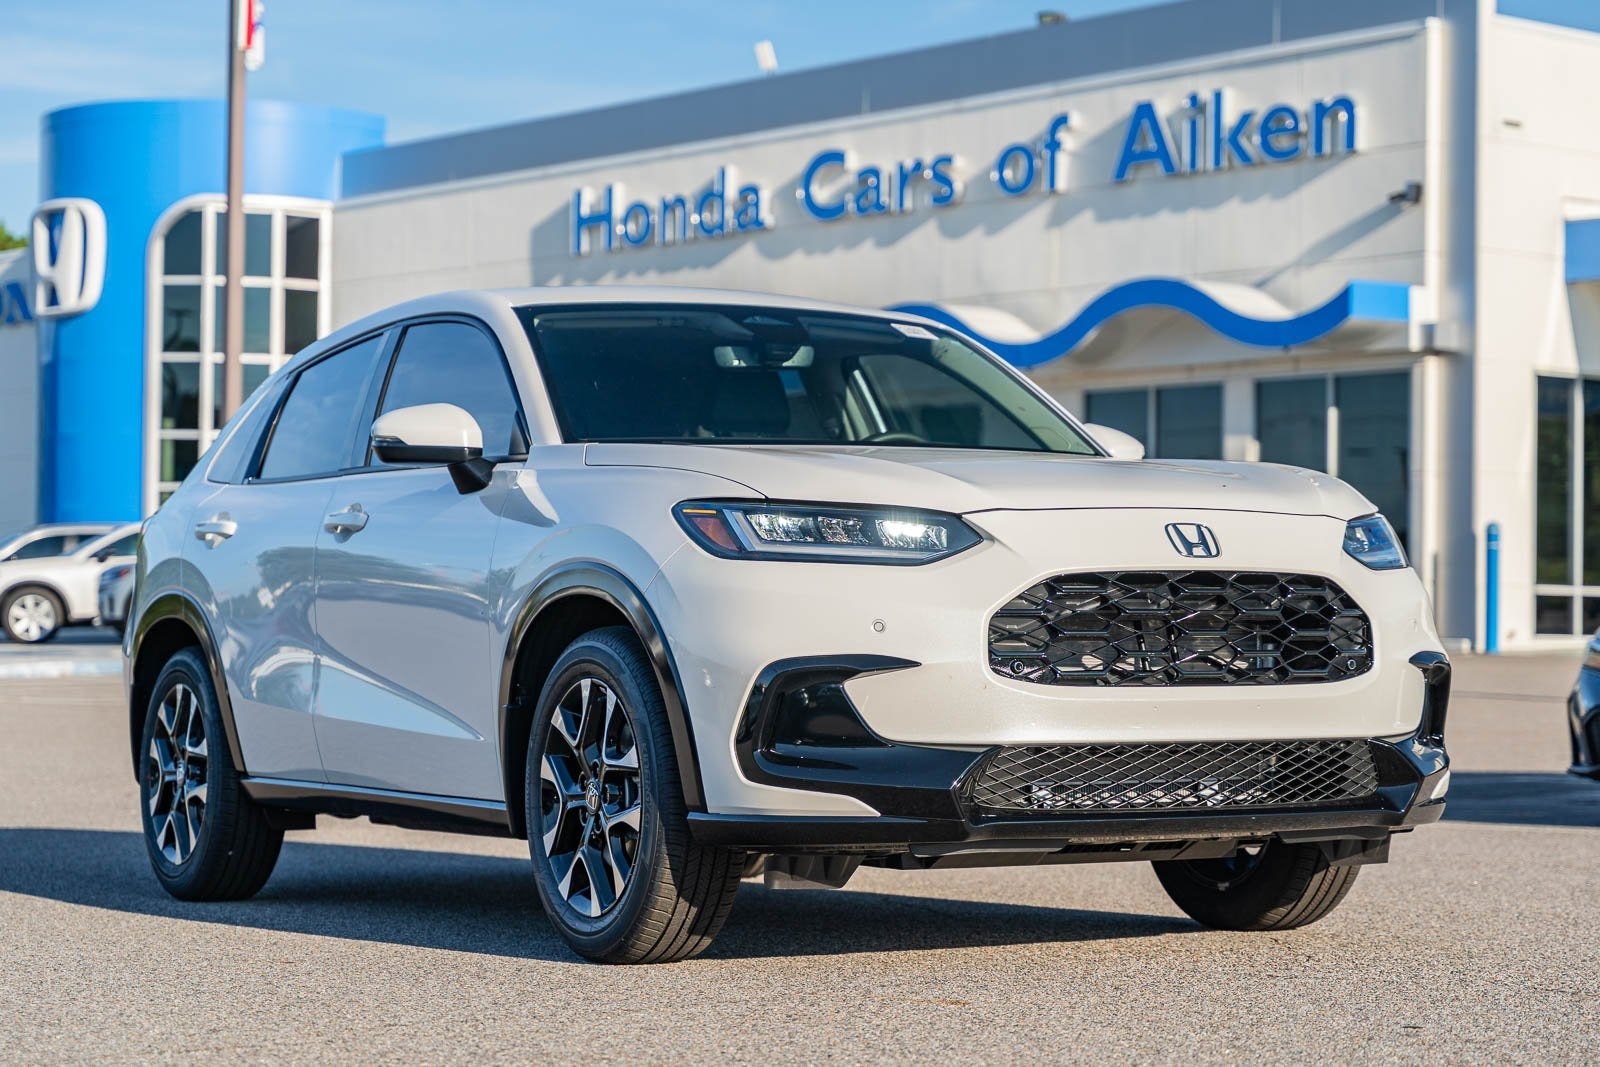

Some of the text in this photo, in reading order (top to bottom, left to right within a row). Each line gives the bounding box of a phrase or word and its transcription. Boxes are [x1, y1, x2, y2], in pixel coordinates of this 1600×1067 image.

[571, 89, 1358, 256] Honda Cars of Aiken
